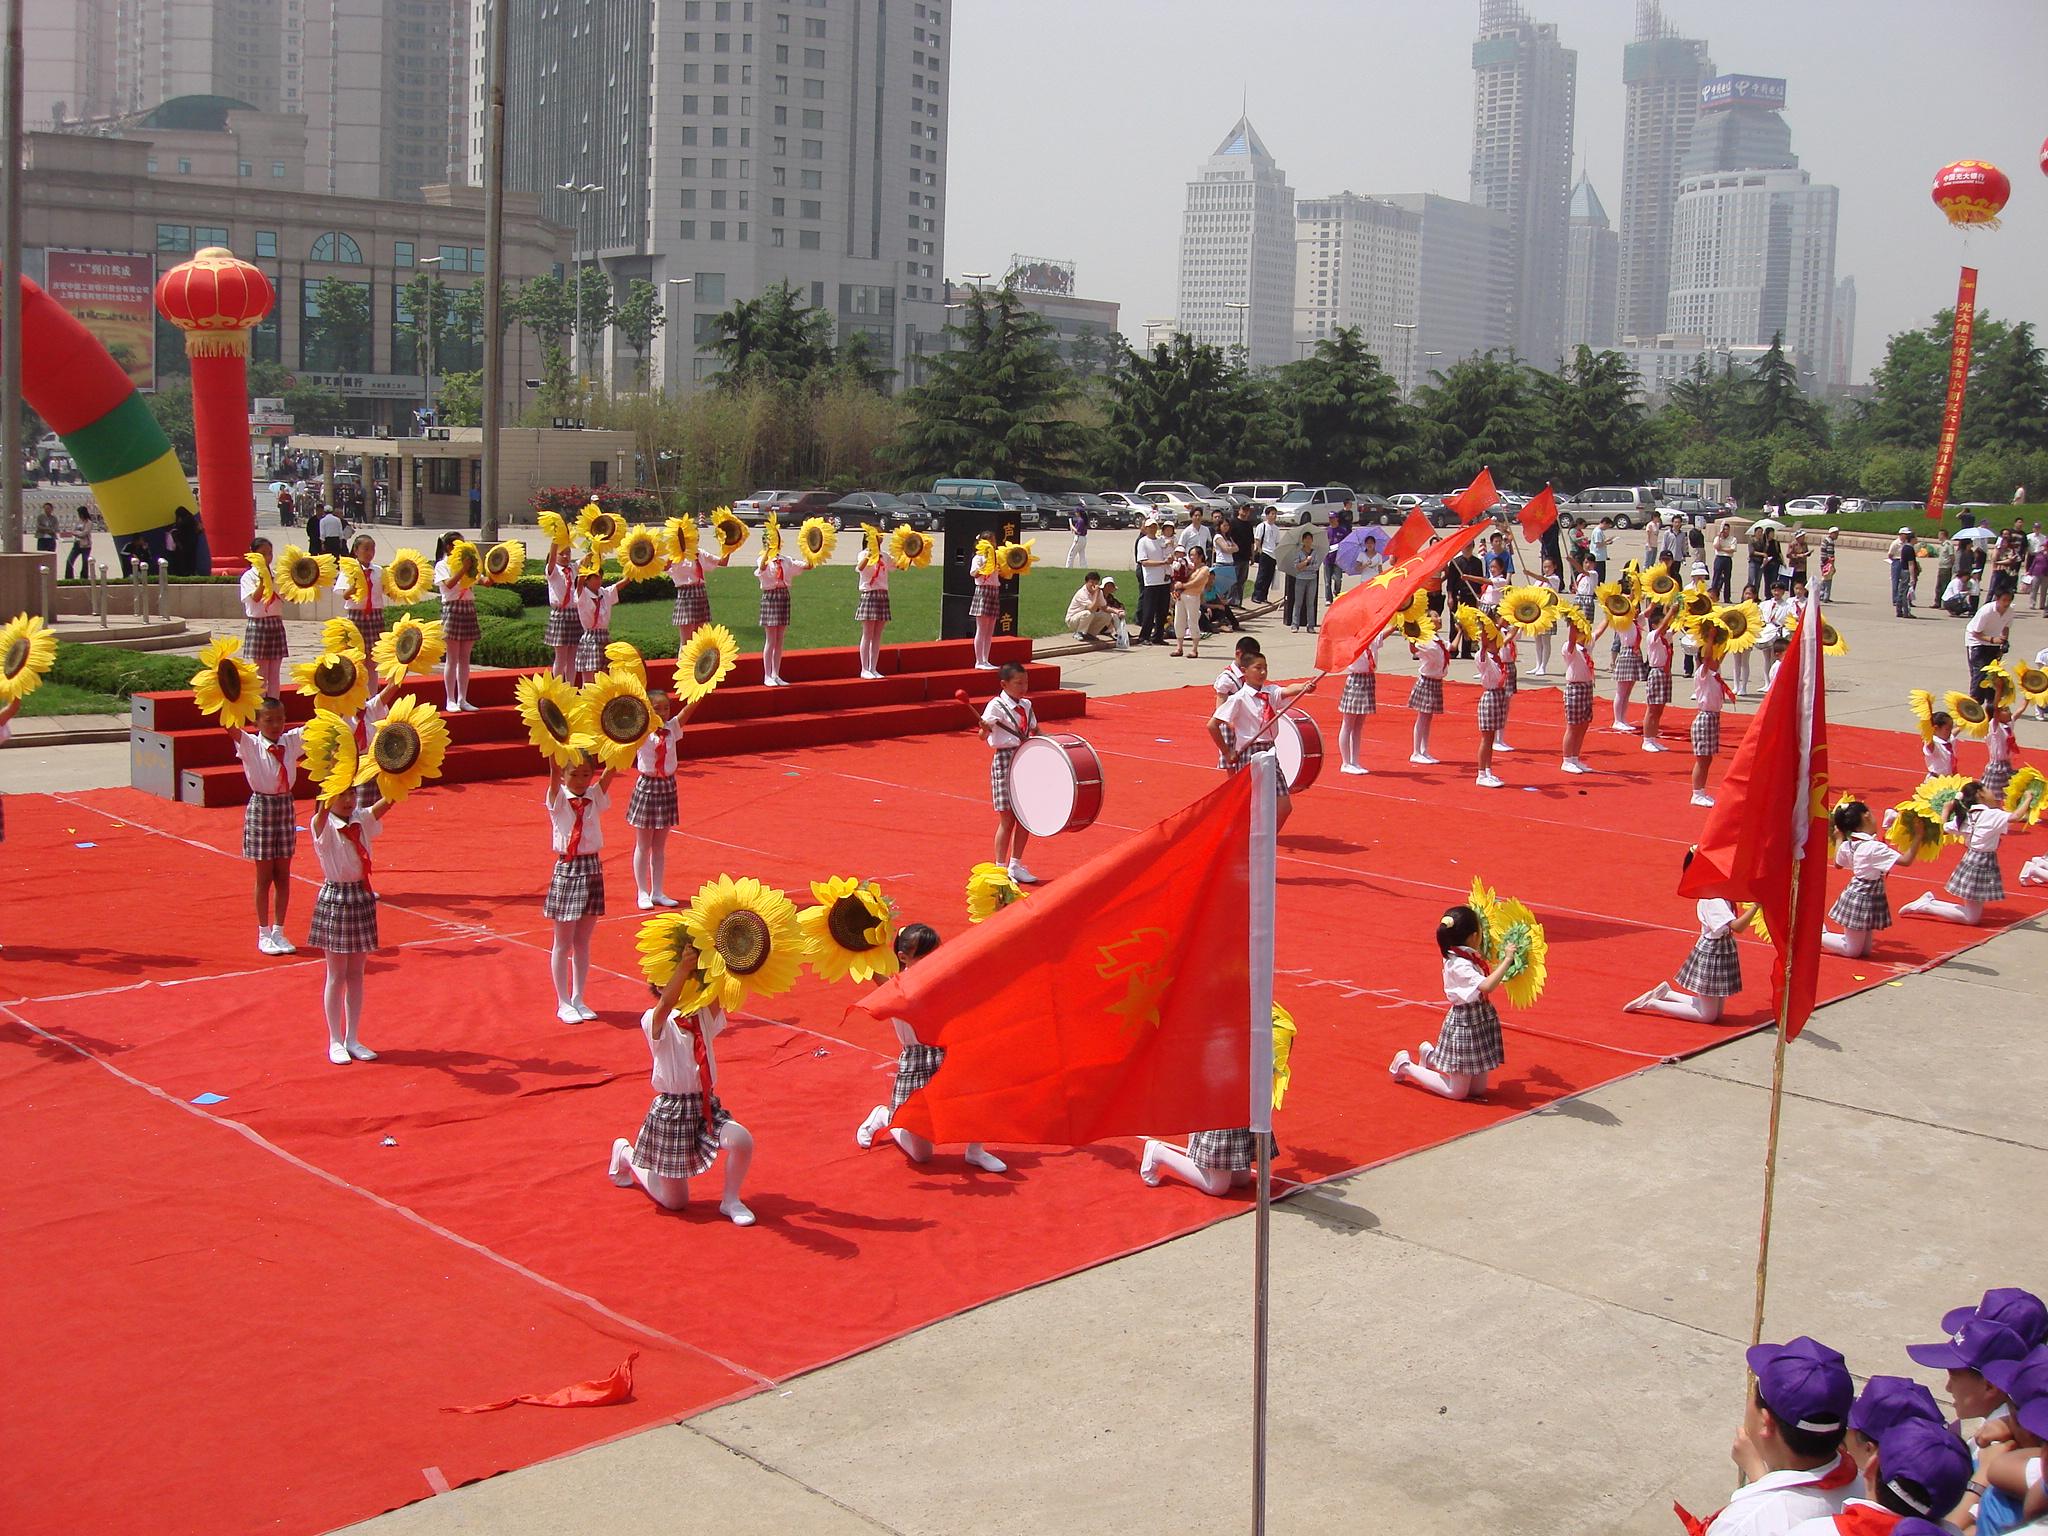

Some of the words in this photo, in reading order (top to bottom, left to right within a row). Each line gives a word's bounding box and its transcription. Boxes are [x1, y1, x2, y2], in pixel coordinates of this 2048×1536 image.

[1943, 172, 1985, 182] 中国光大银行
[1003, 522, 1015, 543] 声
[1001, 613, 1013, 632] 音
